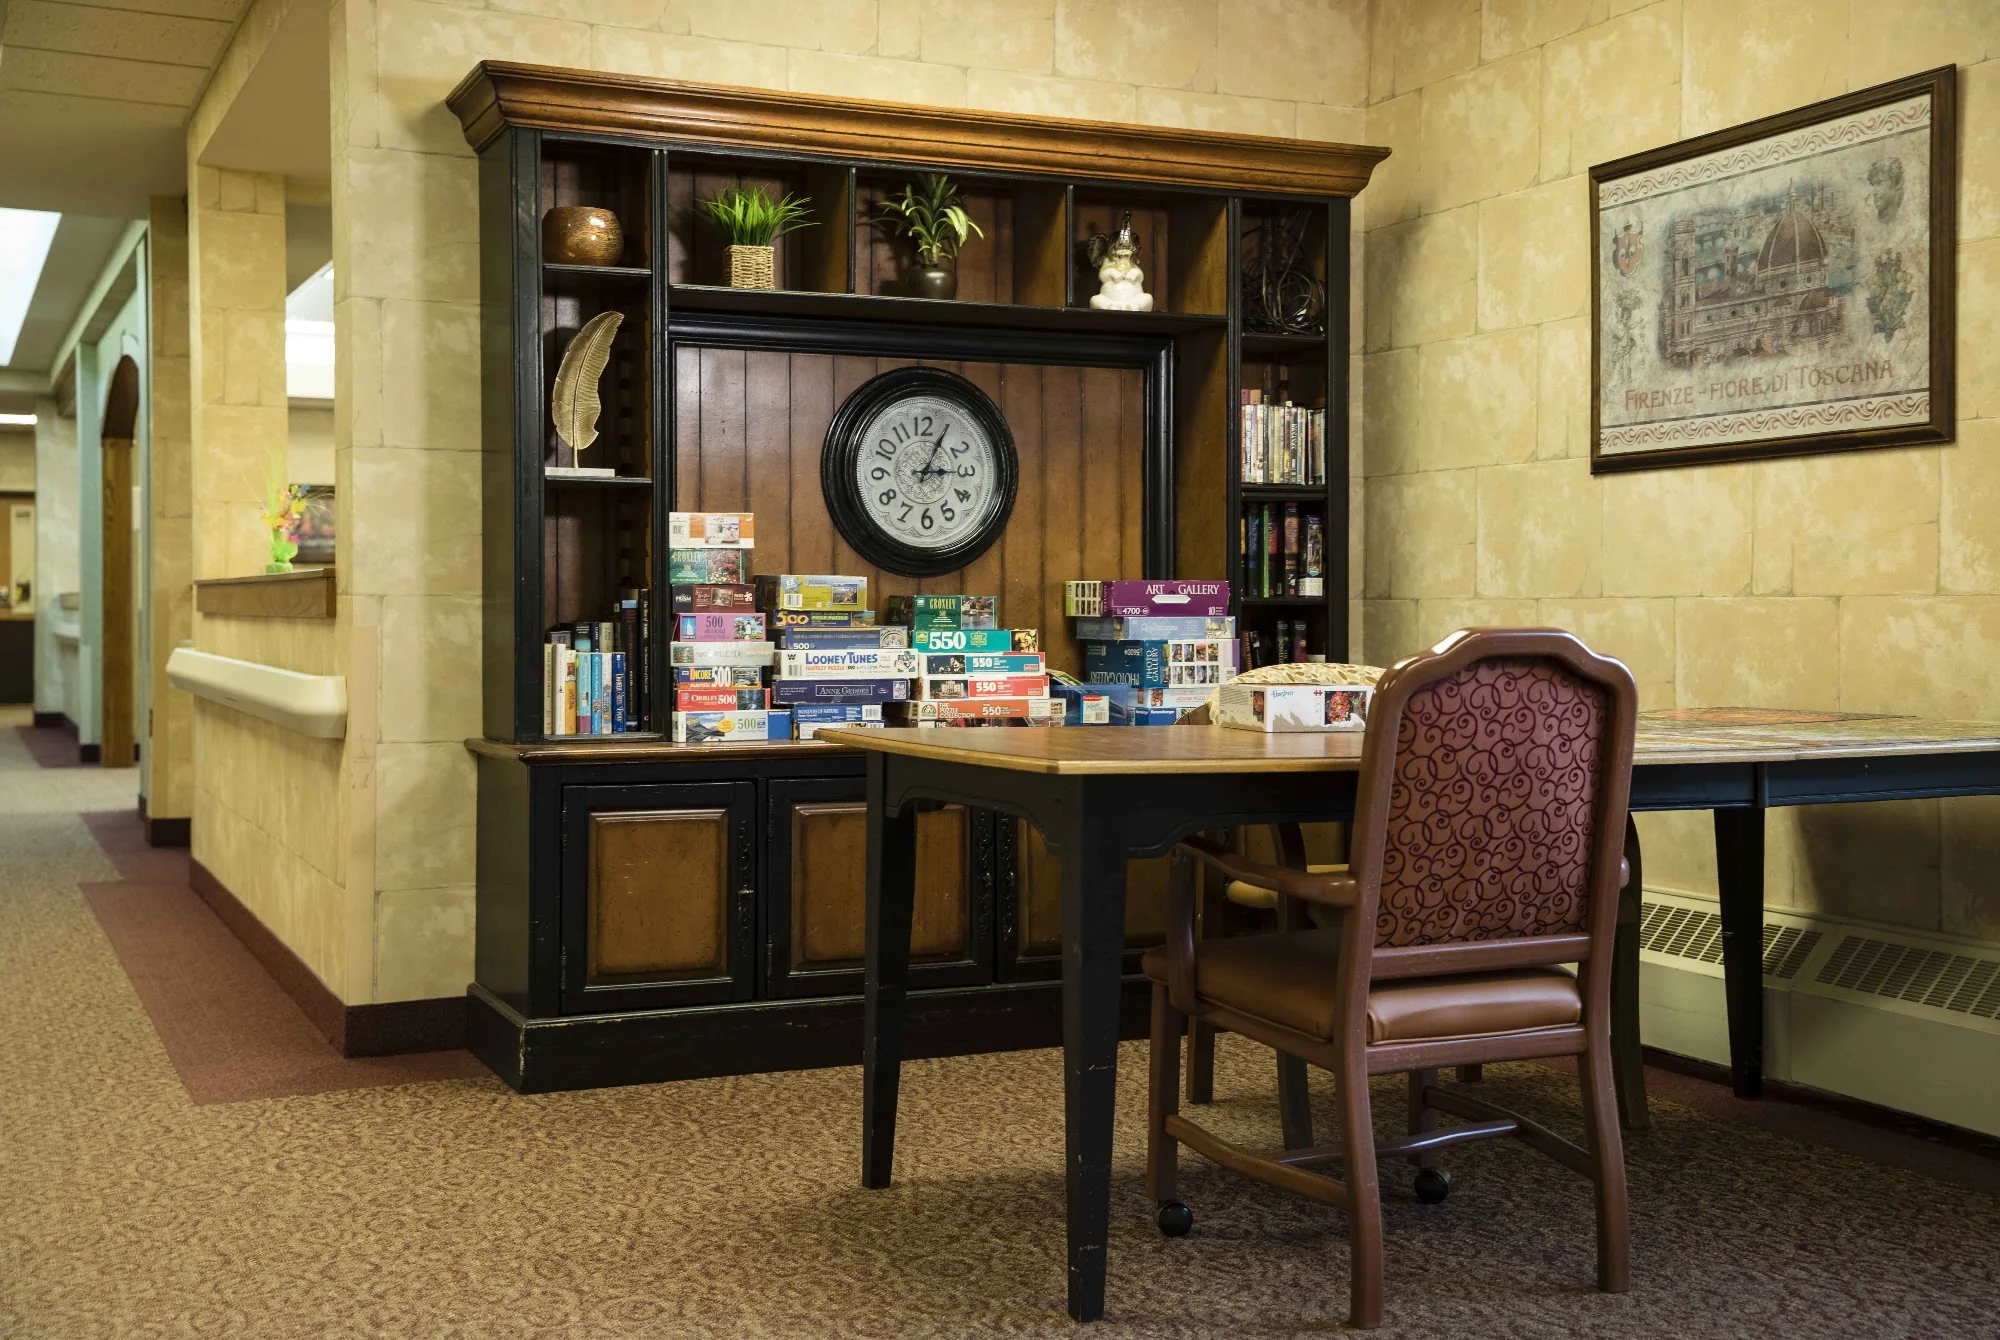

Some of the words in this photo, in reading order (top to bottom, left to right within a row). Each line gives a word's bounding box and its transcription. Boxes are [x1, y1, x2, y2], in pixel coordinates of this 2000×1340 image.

[1624, 386, 1695, 412] FIRENZE
[1710, 377, 1762, 402] FIORE
[1772, 372, 1790, 394] DI
[1797, 359, 1896, 389] TOSCANA
[892, 422, 911, 444] 11
[914, 416, 933, 436] 12
[876, 438, 896, 461] 10
[950, 440, 970, 459] 2
[871, 466, 891, 481] 9
[957, 464, 976, 478] 3
[878, 488, 896, 506] 8
[954, 488, 972, 504] 4
[897, 500, 914, 523] 7
[920, 508, 934, 530] 6
[940, 500, 956, 522] 5
[1146, 584, 1166, 595] ART
[1178, 584, 1220, 595] GALLERY
[706, 616, 723, 628] 500
[776, 610, 809, 626] 500
[929, 632, 966, 650] 550
[805, 652, 846, 664] LOONEY
[847, 652, 878, 664] TUNES
[973, 658, 992, 667] 550
[690, 668, 711, 680] ENCORE
[712, 666, 731, 688] 500
[976, 682, 996, 692] 550
[718, 695, 736, 704] 500
[982, 706, 1001, 715] 550
[738, 718, 756, 729] 500
